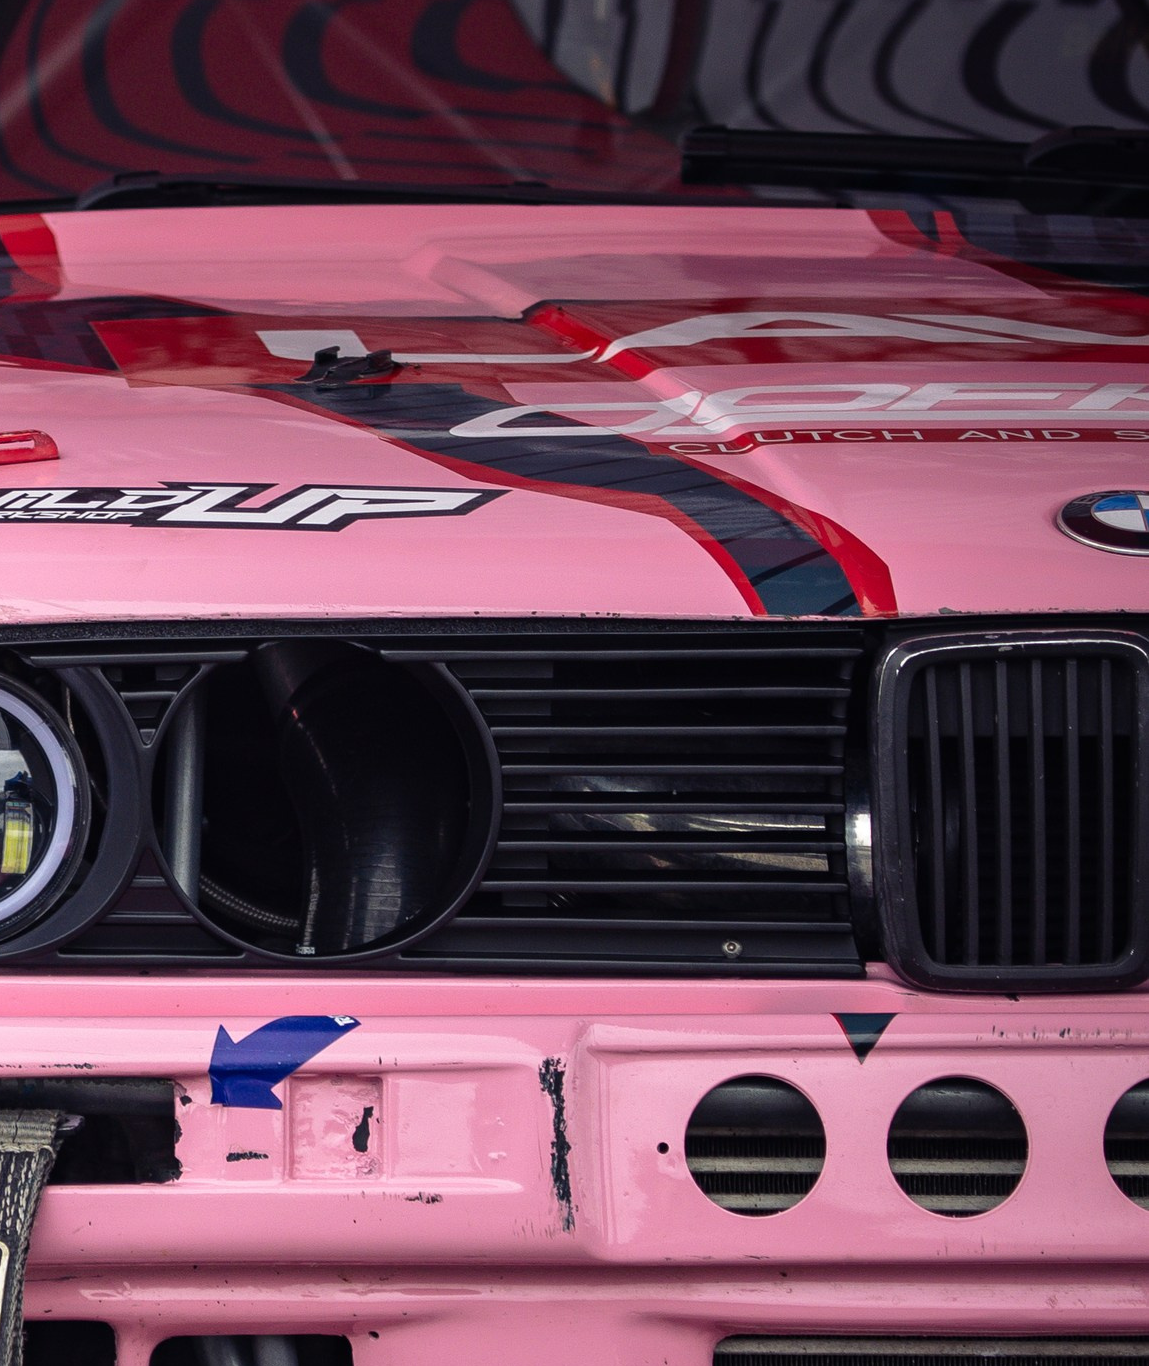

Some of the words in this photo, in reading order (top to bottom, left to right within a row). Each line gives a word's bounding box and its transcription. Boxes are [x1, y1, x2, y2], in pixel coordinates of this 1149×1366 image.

[668, 430, 825, 454] CLUTCH
[957, 430, 1081, 441] AND
[156, 486, 484, 525] UP
